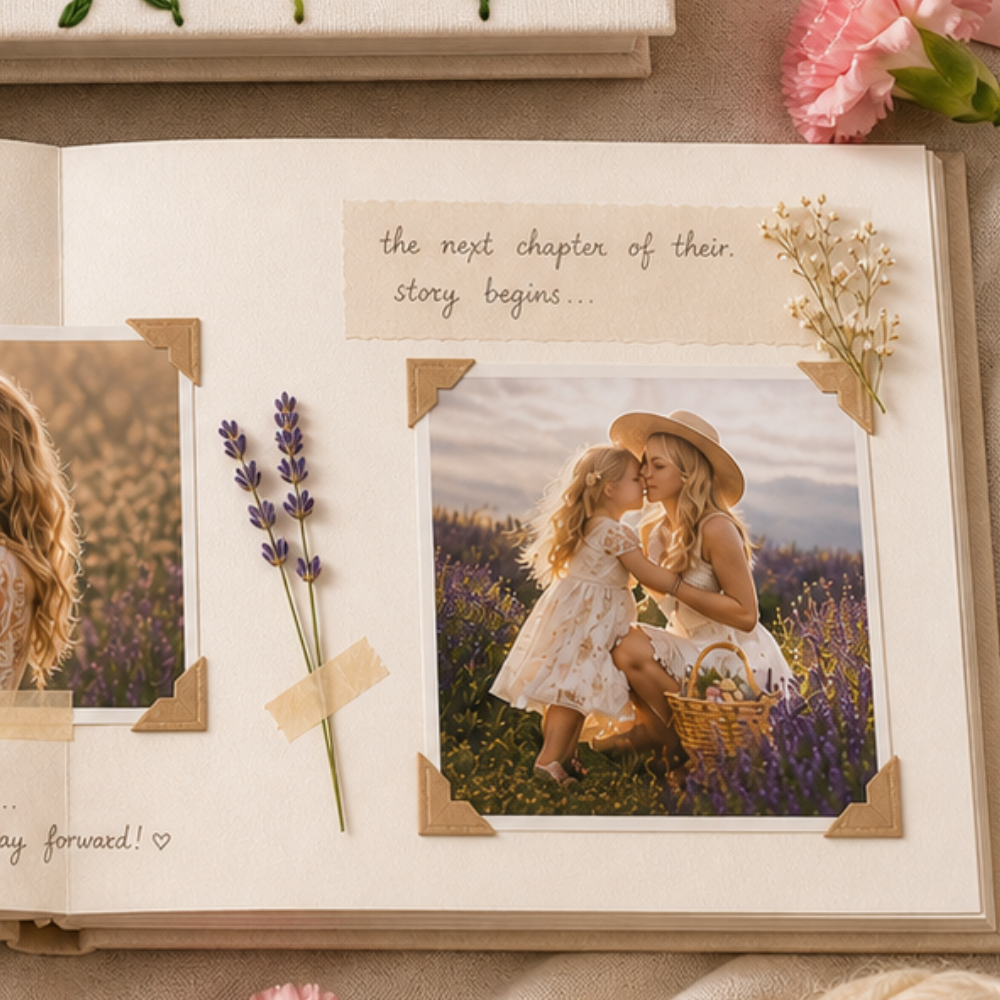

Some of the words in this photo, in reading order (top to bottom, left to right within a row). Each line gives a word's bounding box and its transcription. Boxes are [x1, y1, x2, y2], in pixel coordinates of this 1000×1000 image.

[380, 225, 420, 255] the
[440, 231, 494, 263] next
[515, 228, 607, 270] chapter
[627, 231, 655, 270] of
[671, 230, 734, 258] their.
[393, 278, 460, 319] story
[484, 277, 594, 319] begins...
[42, 825, 143, 864] forward!
